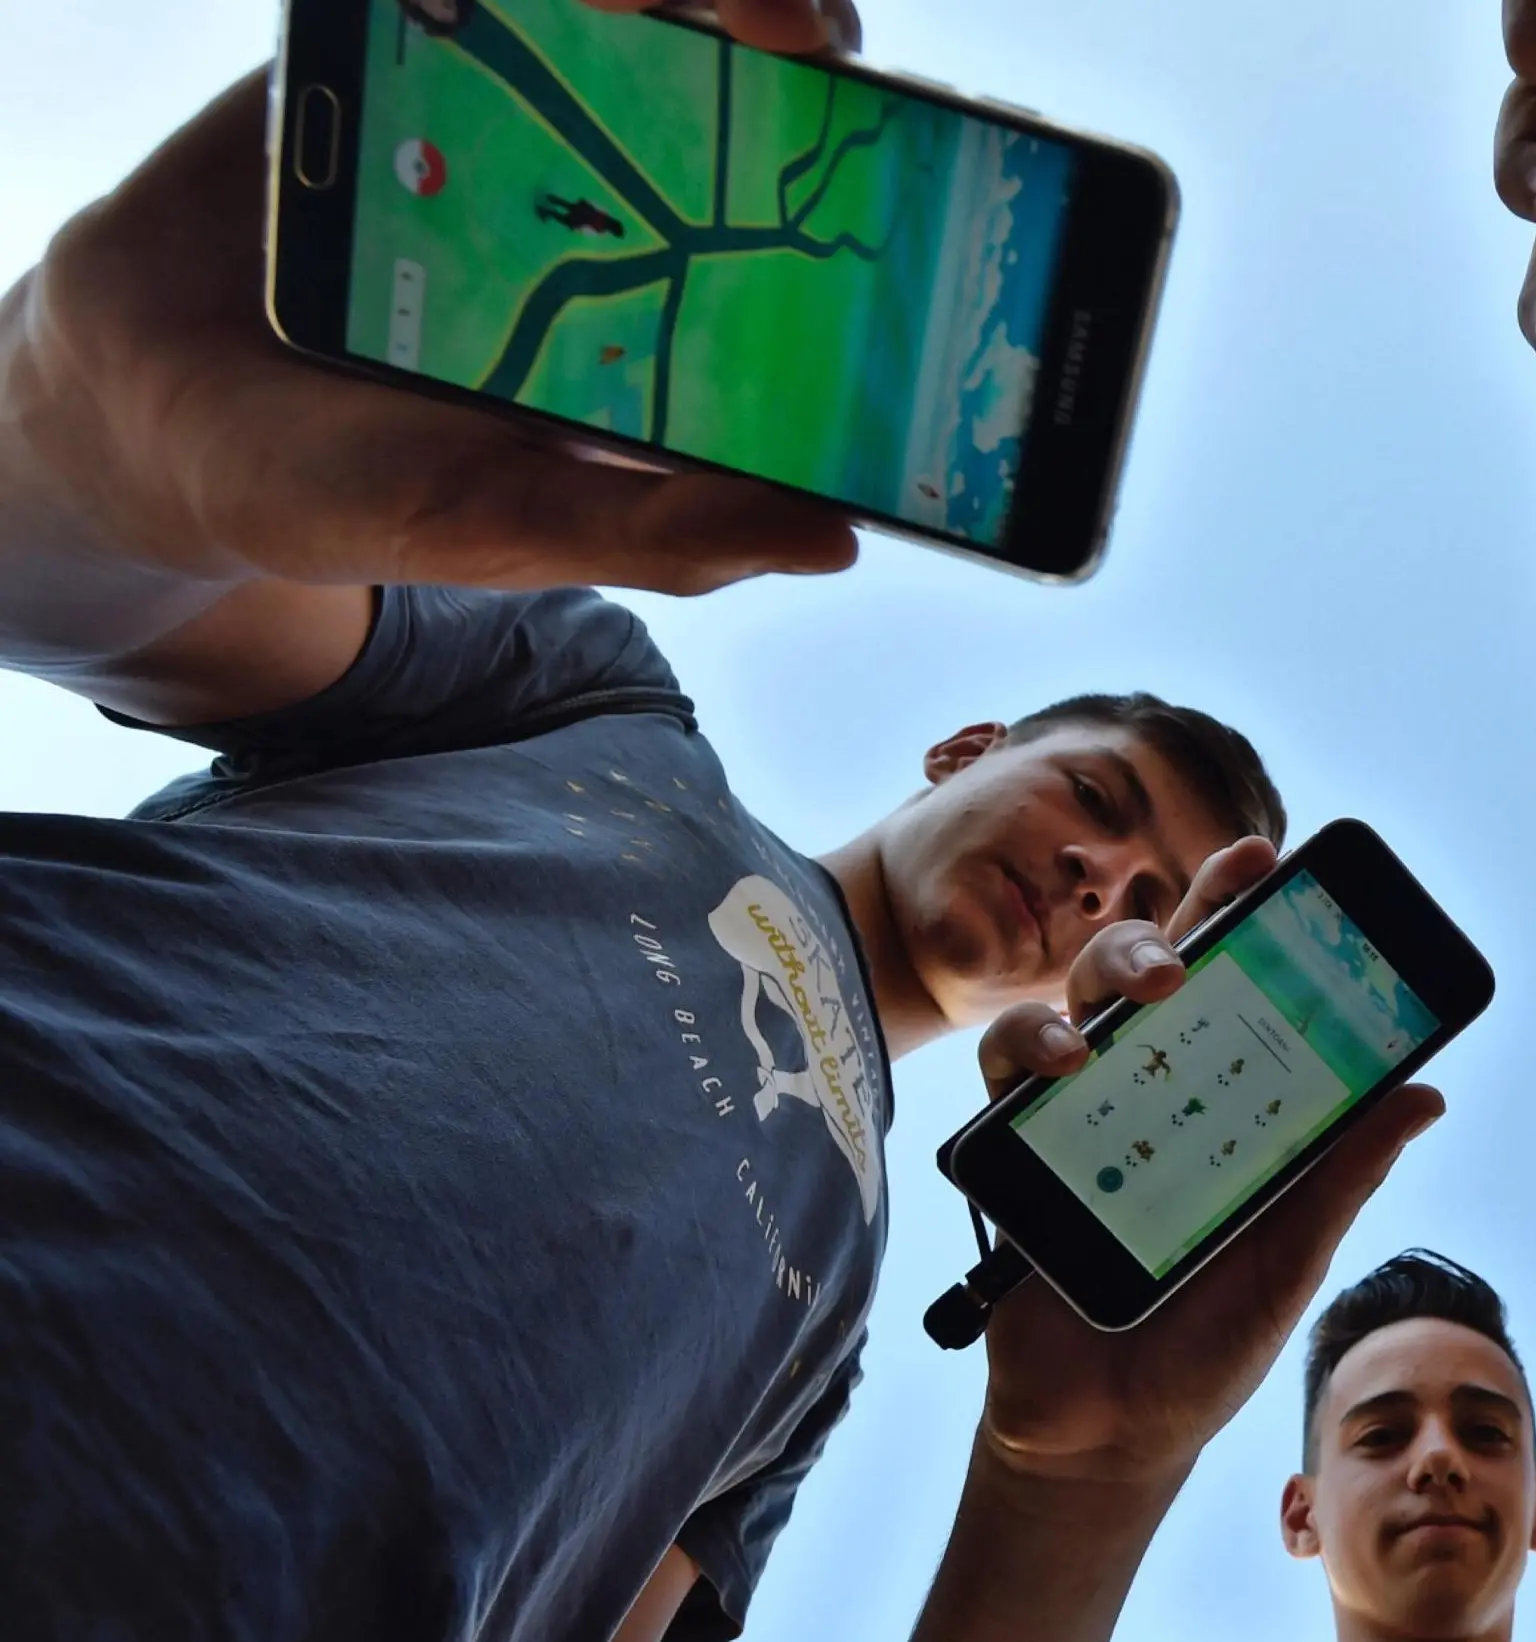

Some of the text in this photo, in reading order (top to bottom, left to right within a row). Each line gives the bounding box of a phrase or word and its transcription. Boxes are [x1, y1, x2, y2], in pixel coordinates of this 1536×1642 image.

[1053, 309, 1092, 426] SAMSUNG
[630, 913, 681, 986] LONG
[674, 1008, 735, 1117] BEACH
[747, 904, 826, 1055] without
[820, 1056, 866, 1173] limits
[788, 916, 873, 1117] SKATE
